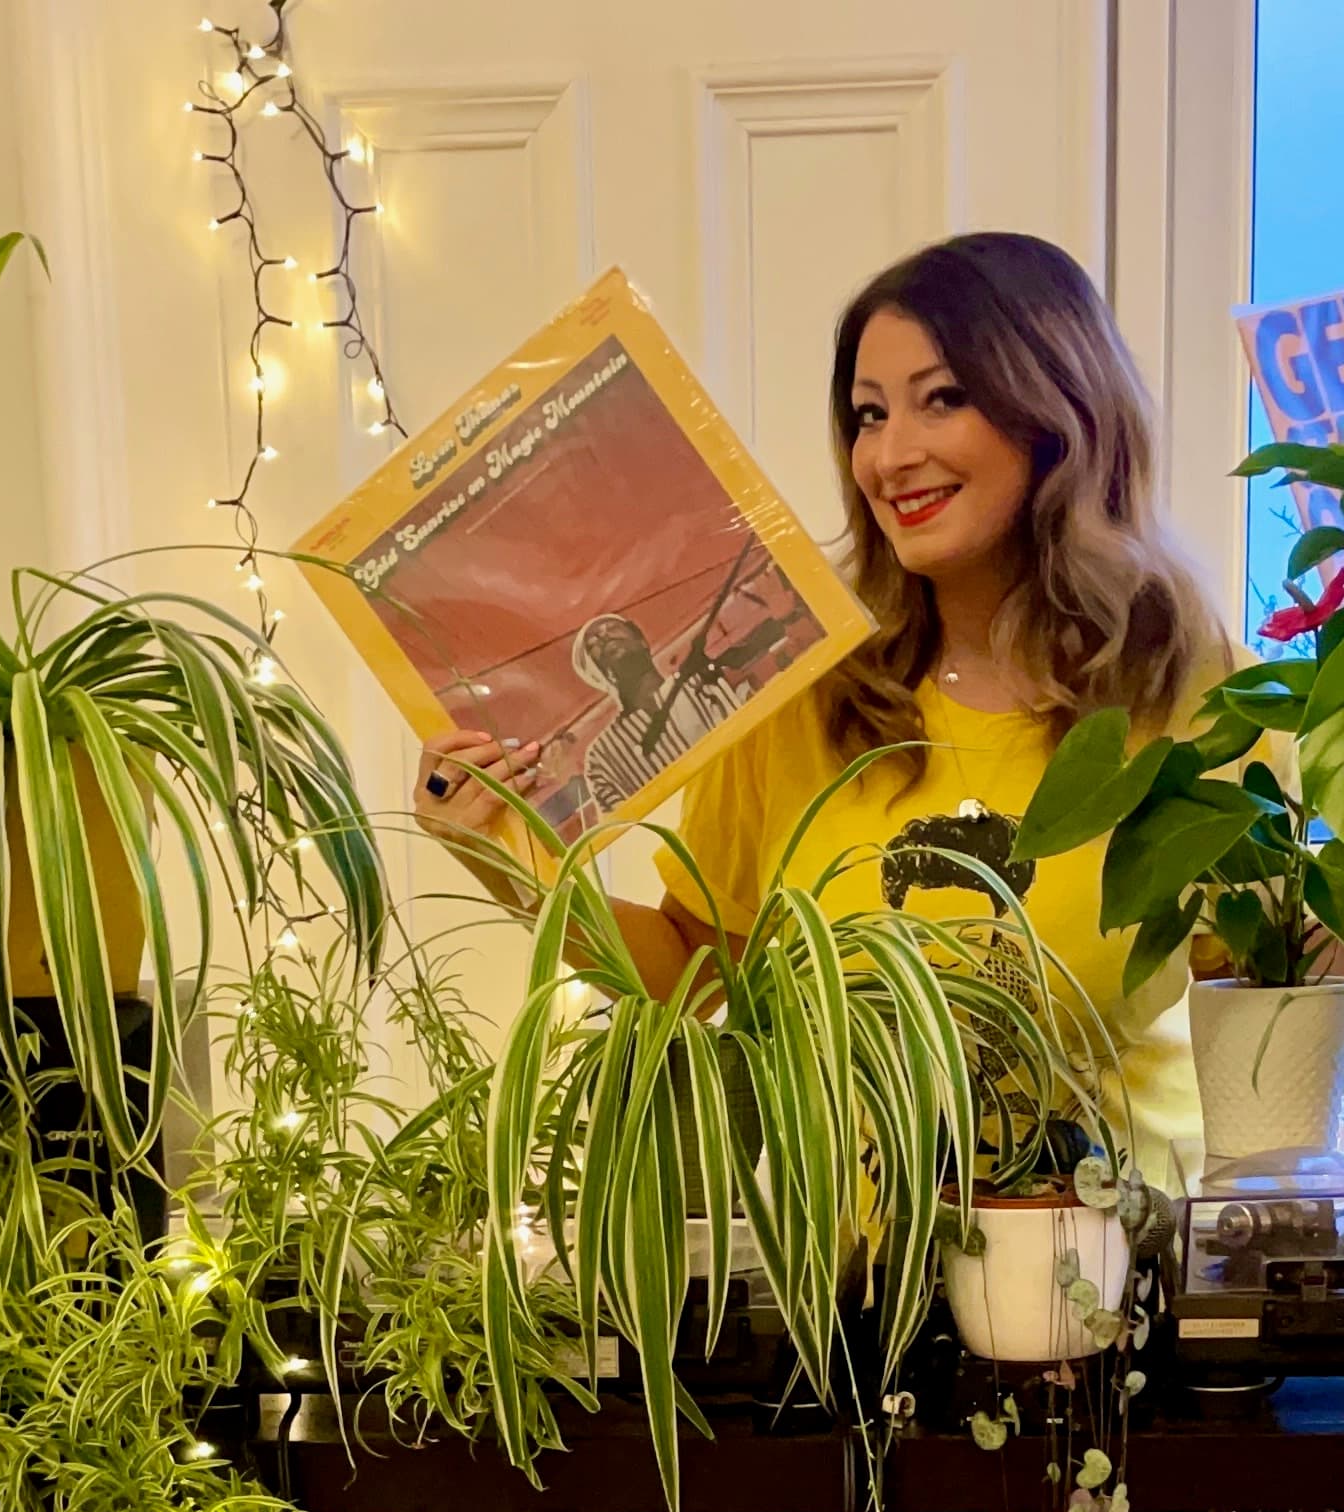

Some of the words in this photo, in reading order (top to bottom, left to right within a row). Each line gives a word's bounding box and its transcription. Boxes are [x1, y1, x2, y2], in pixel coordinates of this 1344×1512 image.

[395, 493, 466, 552] Sunrise
[467, 475, 486, 497] on
[485, 426, 543, 480] Magic
[542, 353, 629, 430] Mountain
